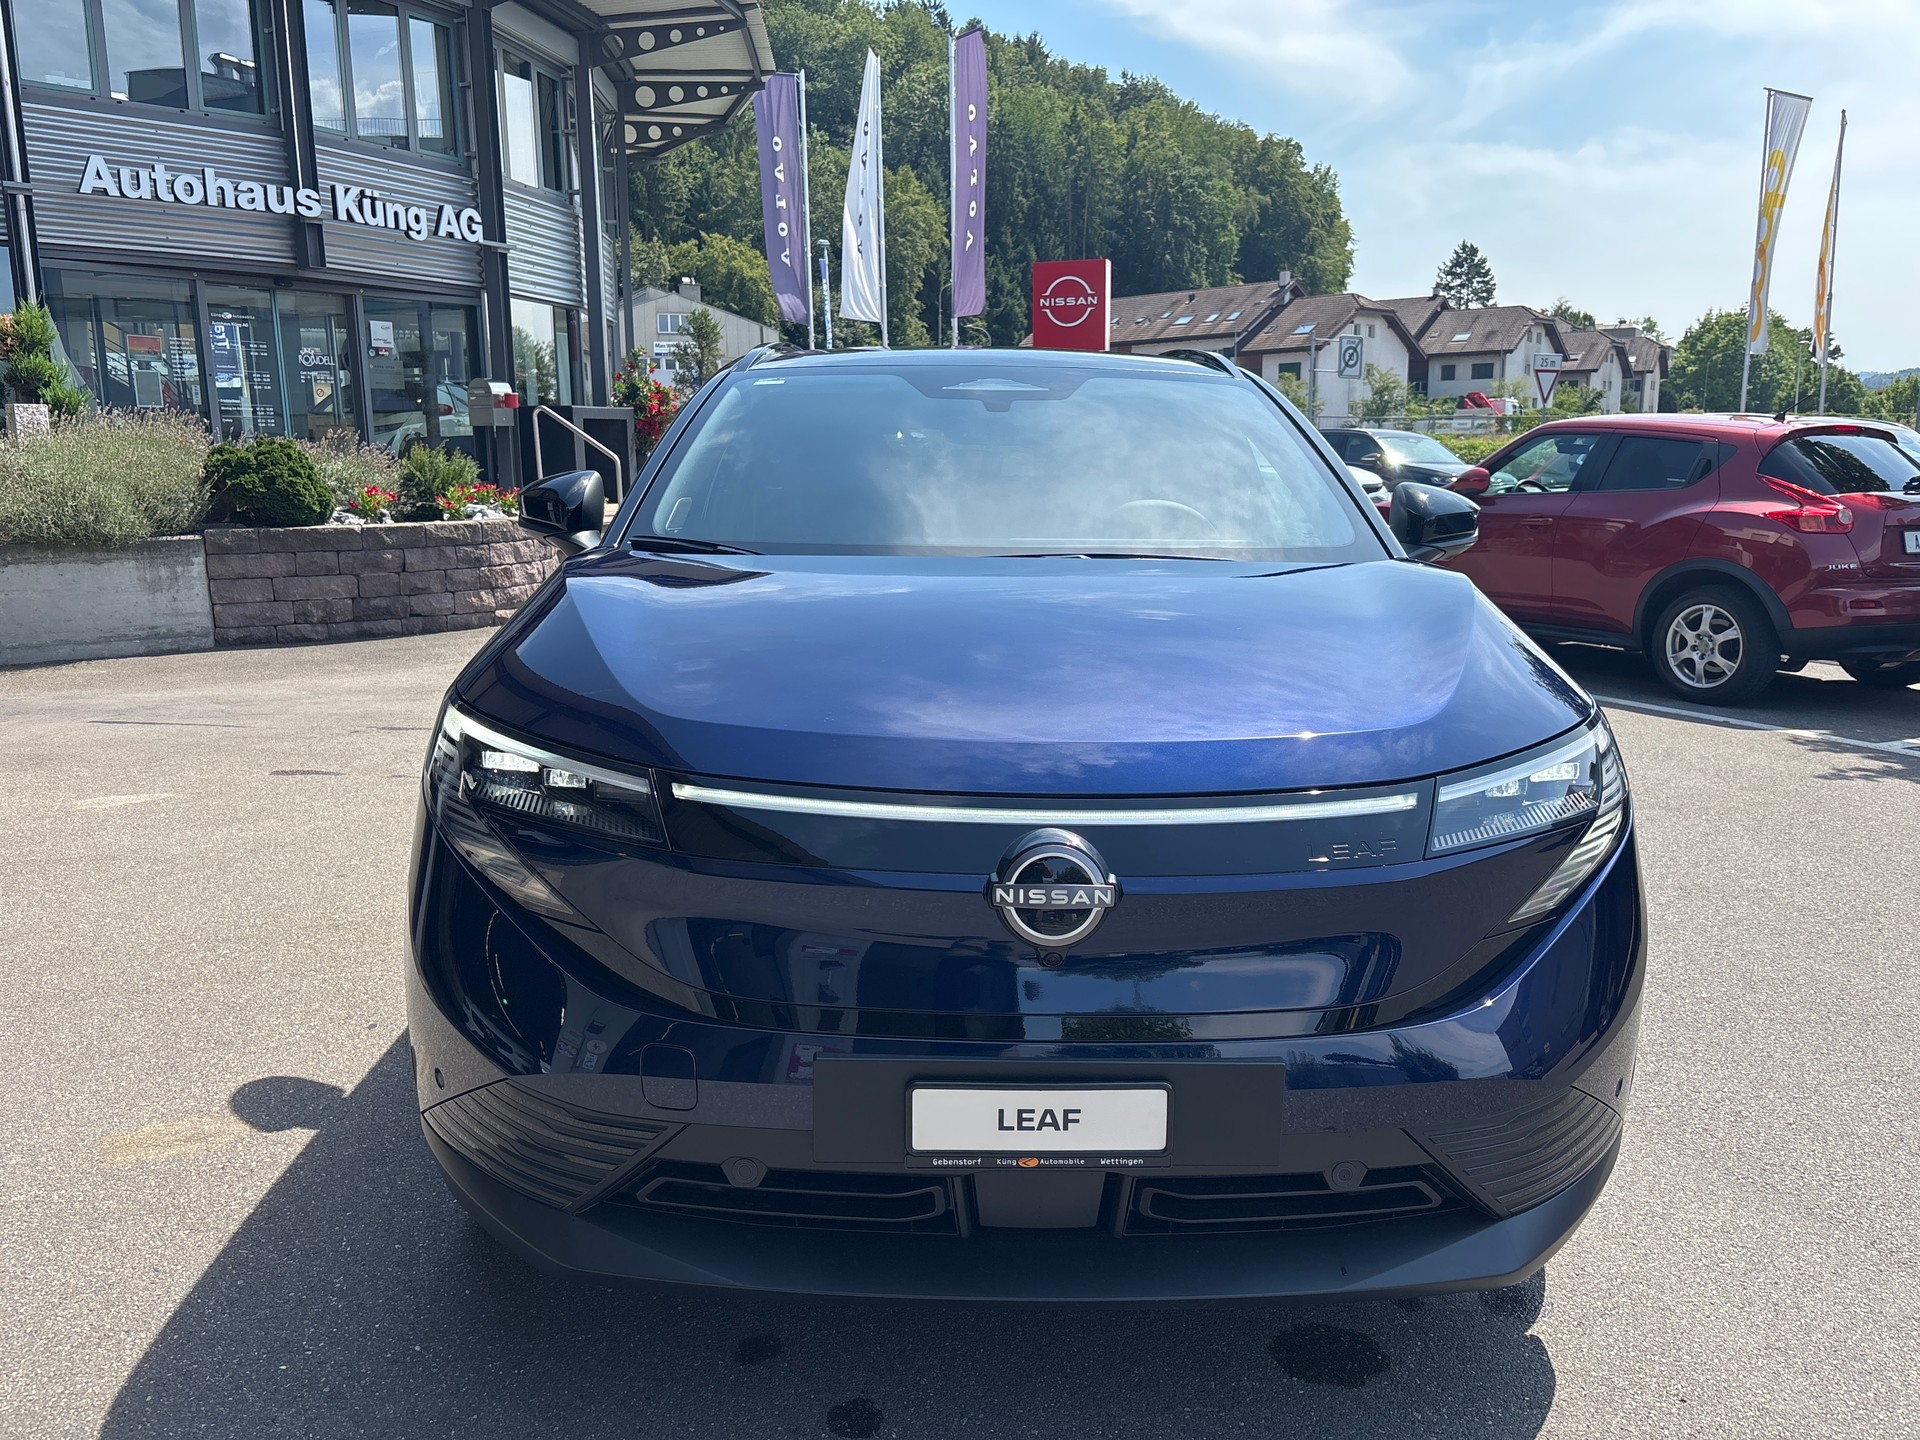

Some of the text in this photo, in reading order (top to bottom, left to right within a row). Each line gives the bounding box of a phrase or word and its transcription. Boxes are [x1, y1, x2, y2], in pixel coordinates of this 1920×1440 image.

[966, 104, 978, 251] VOLVO
[79, 154, 484, 243] Autohaus Küng AG
[1040, 296, 1098, 306] NISSAN
[1540, 357, 1556, 368] 25 m
[1825, 563, 1858, 572] JUKE
[1307, 839, 1399, 863] LEAF
[994, 886, 1113, 905] NISSAN
[997, 1108, 1082, 1132] LEAF
[932, 1157, 1144, 1167] Gebenstorf Küng Automobile Wettingen
